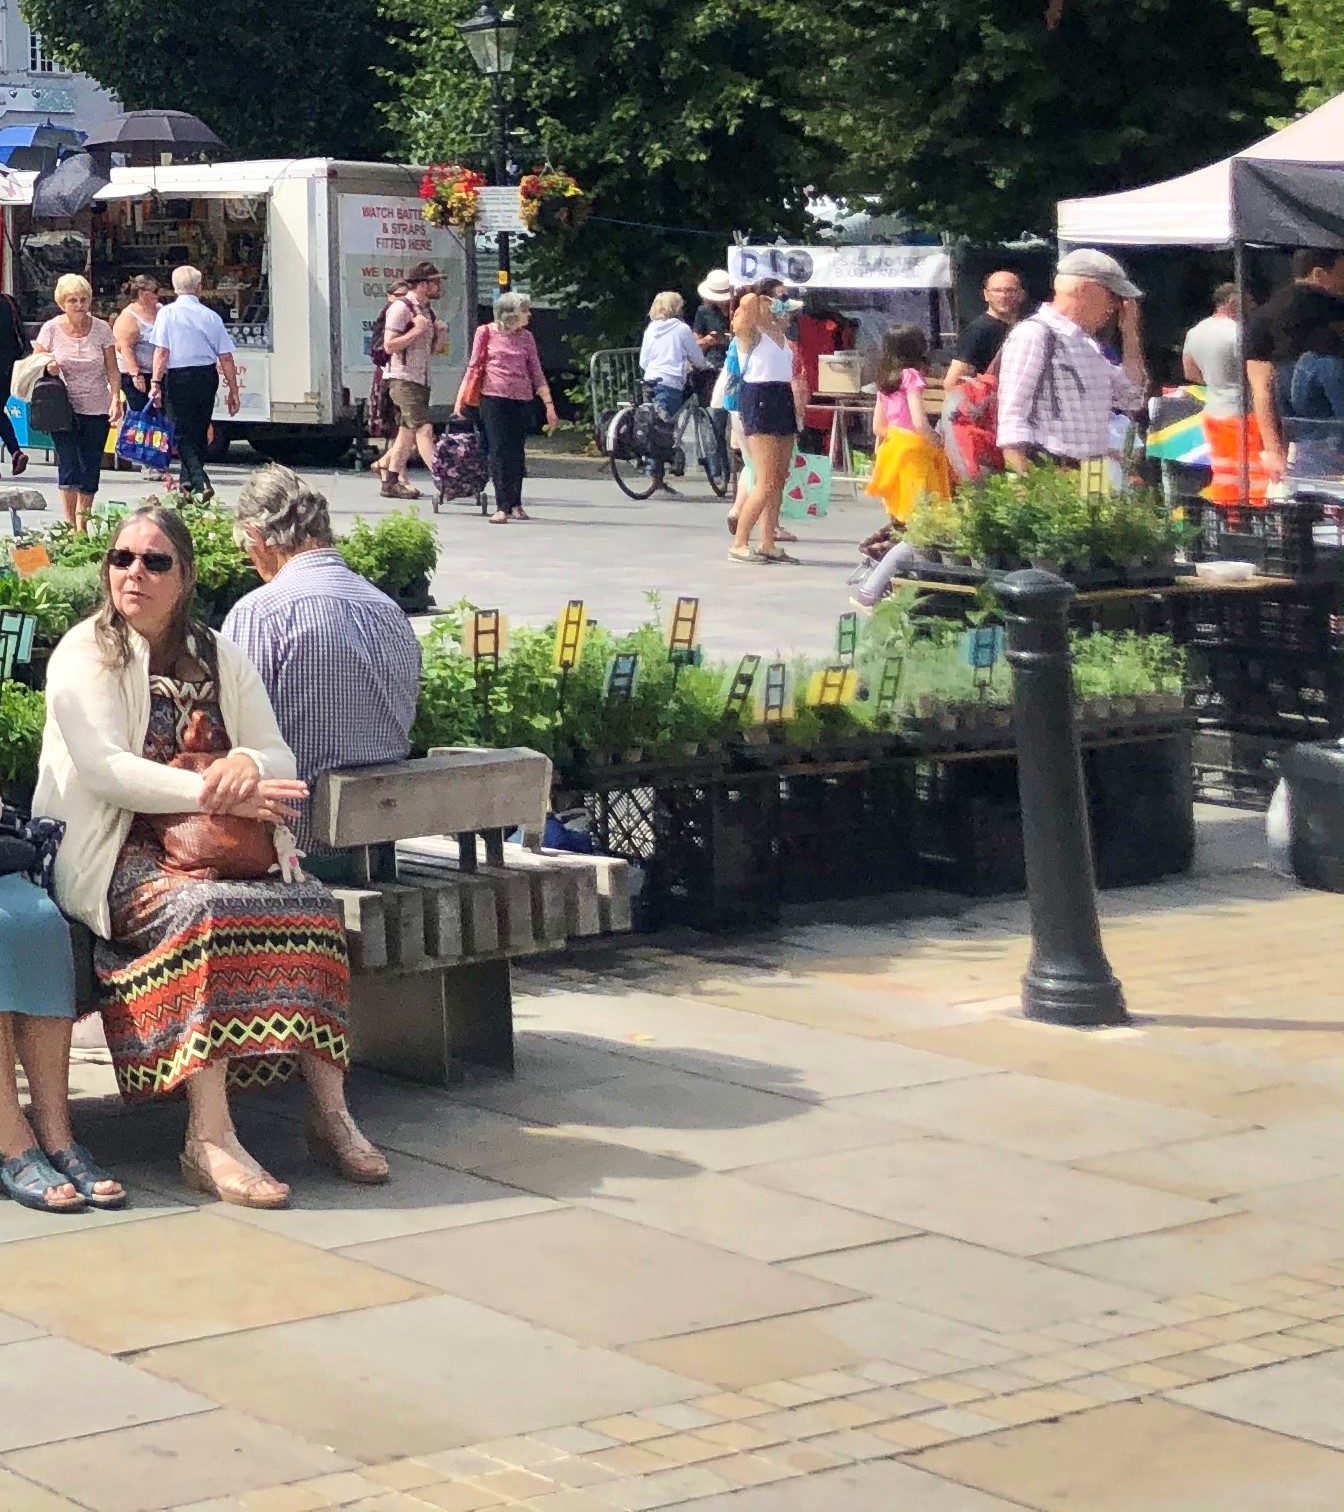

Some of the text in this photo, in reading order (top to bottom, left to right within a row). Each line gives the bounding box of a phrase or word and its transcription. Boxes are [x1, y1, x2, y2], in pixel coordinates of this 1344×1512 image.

[362, 206, 424, 220] WATCH BATTE
[382, 223, 426, 236] & STRAPS
[376, 238, 433, 251] FITTED HERE
[362, 267, 405, 278] WE BUY
